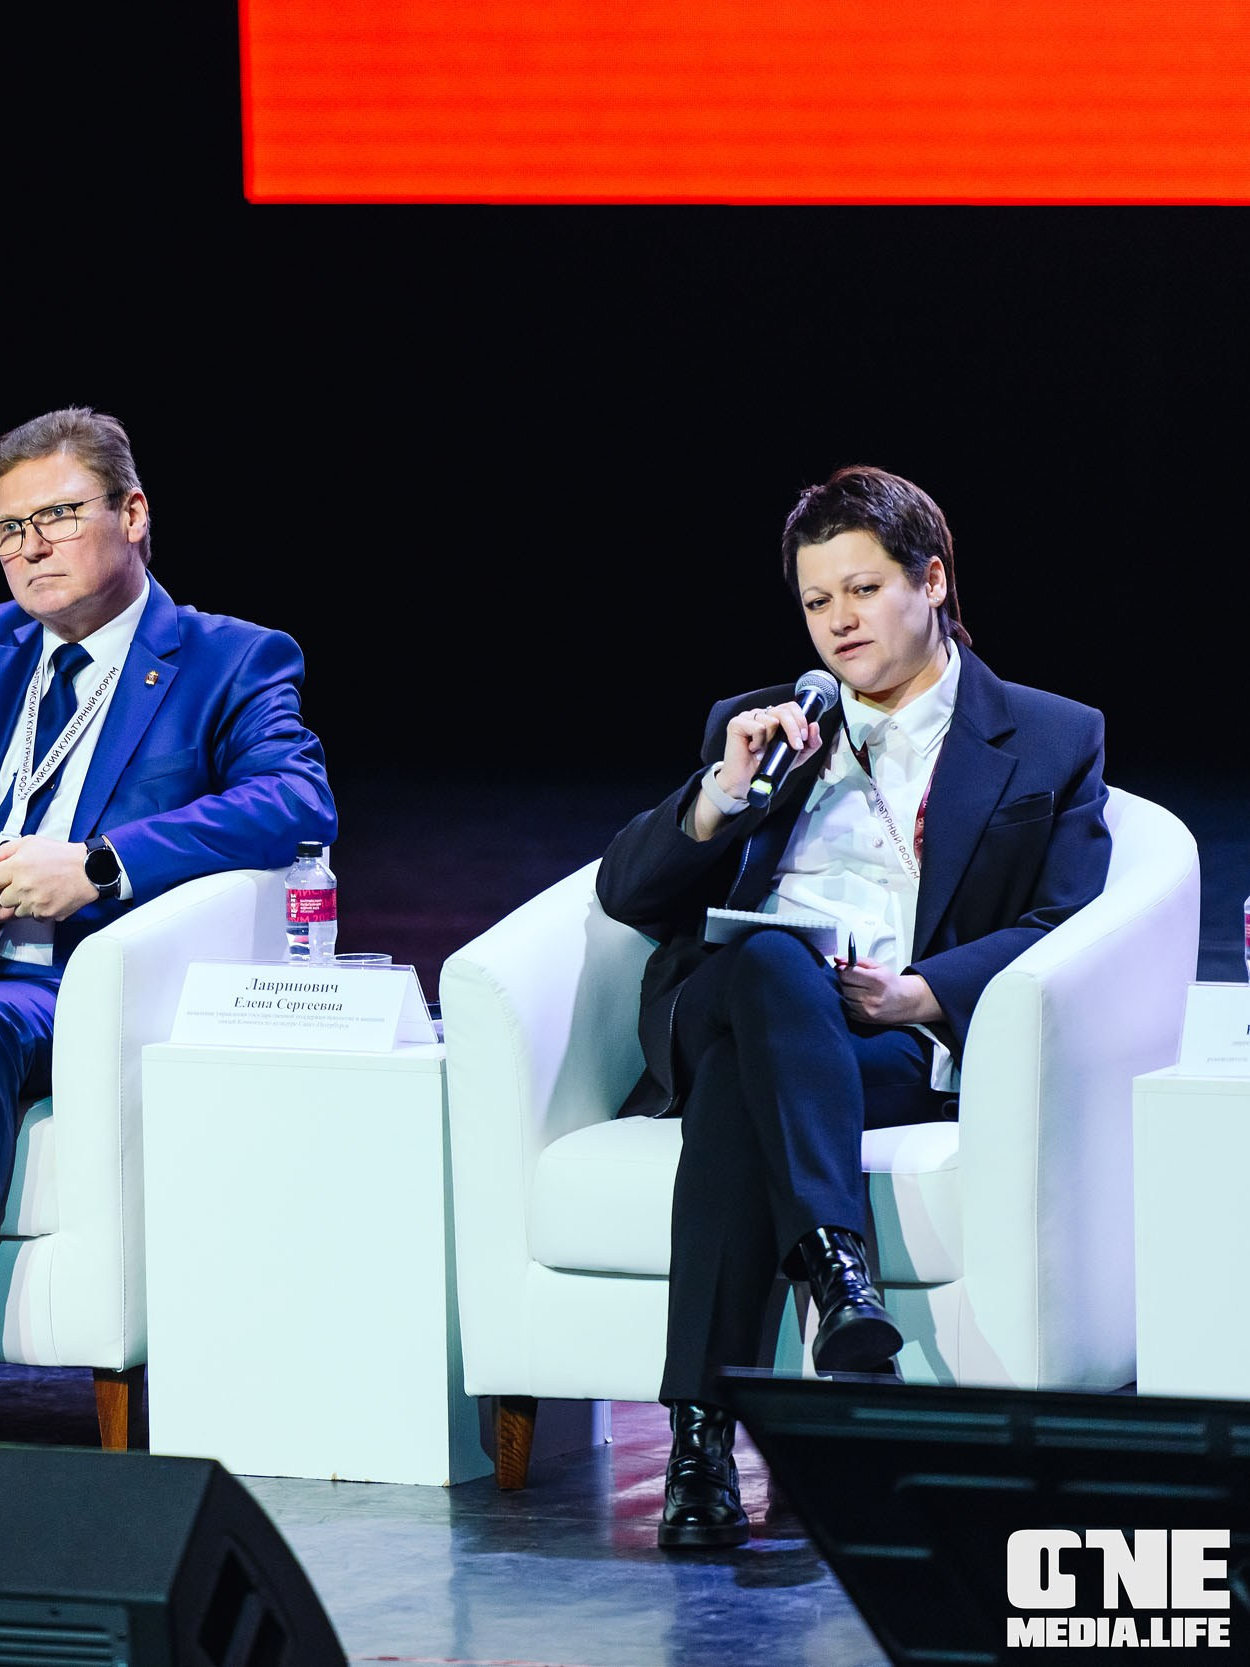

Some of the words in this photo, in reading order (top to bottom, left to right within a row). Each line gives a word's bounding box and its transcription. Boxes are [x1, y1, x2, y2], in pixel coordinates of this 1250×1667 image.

[57, 696, 98, 751] КУЛЬТУРНЫЙ
[95, 666, 120, 698] ФОРУМ
[898, 845, 921, 880] ФОРУМ
[245, 978, 339, 995] Лавринович
[234, 997, 273, 1009] Елена
[276, 998, 343, 1013] Сергеевна
